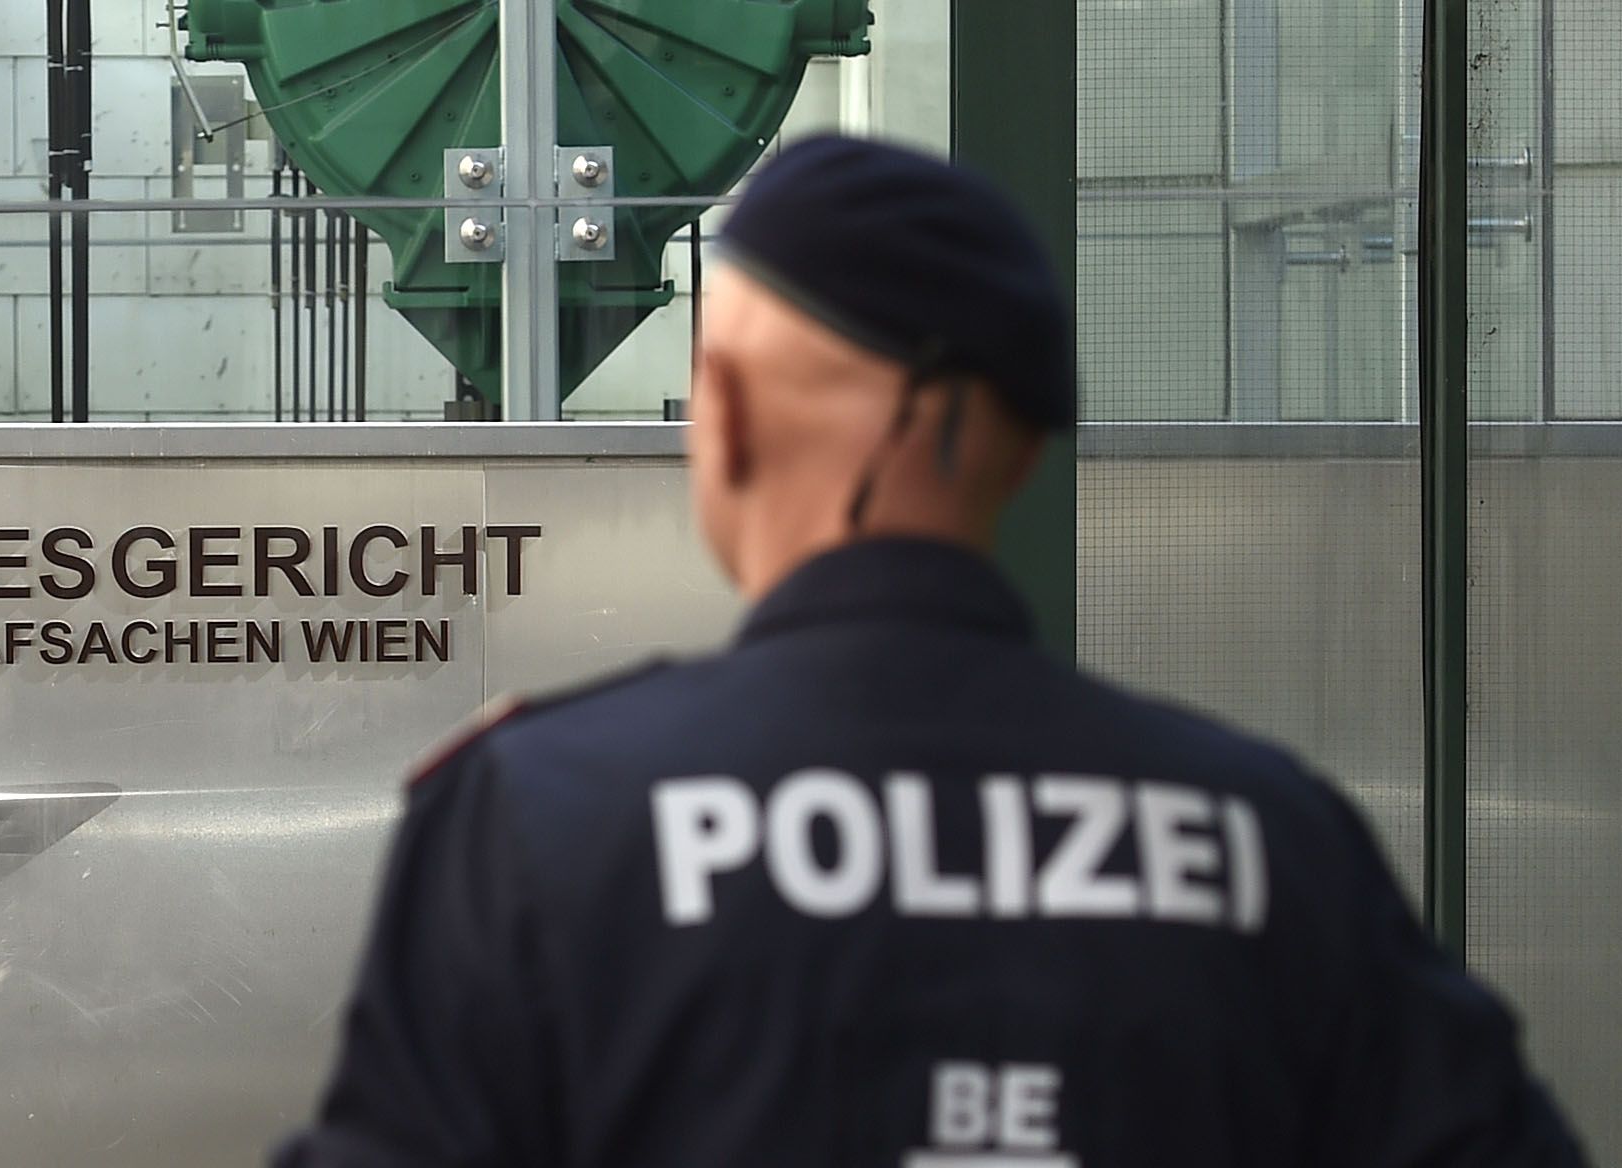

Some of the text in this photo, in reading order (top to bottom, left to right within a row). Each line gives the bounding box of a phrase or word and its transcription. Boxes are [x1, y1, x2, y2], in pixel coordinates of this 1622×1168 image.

[300, 618, 450, 663] WIEN
[650, 767, 1268, 932] POLIZEI
[929, 1062, 1062, 1150] BE
